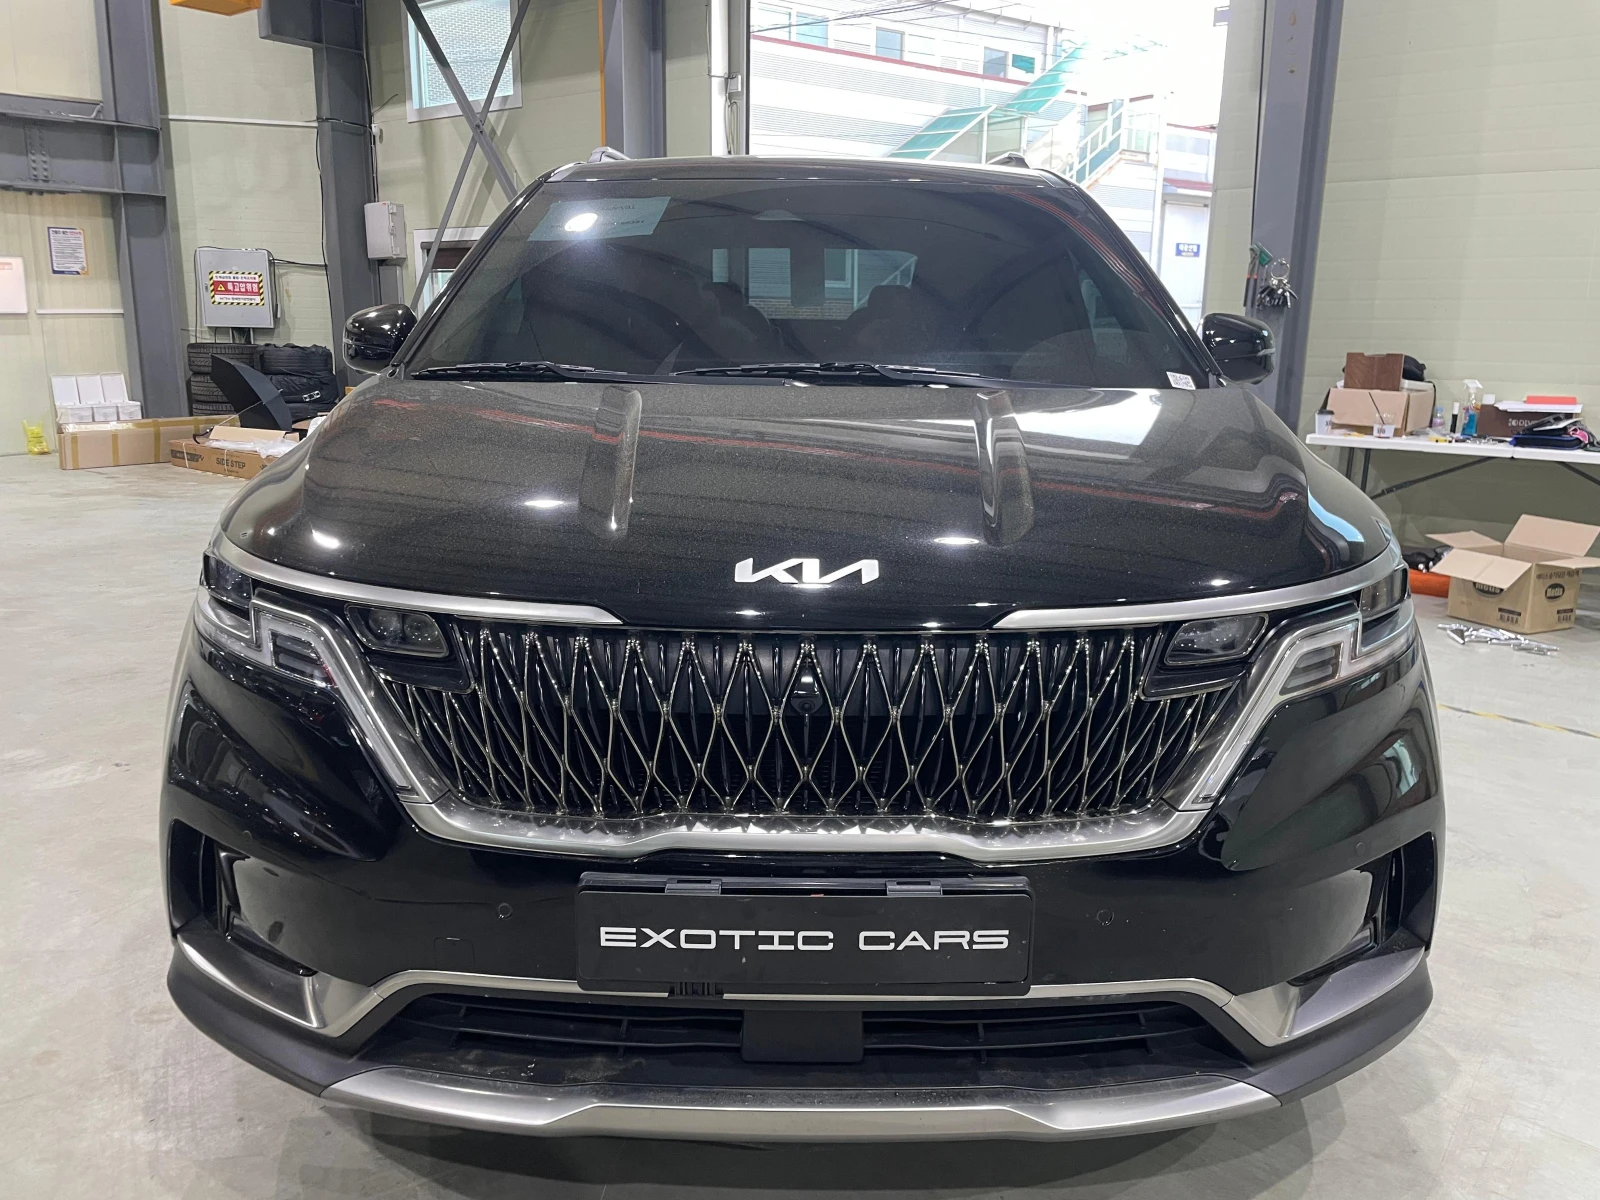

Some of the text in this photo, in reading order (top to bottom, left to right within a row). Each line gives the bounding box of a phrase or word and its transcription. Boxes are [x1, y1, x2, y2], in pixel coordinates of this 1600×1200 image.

[227, 282, 259, 293] 특고압위험
[216, 457, 246, 469] SIDE STEP
[735, 557, 879, 584] KIA
[600, 926, 1009, 951] EXOTIC CARS
